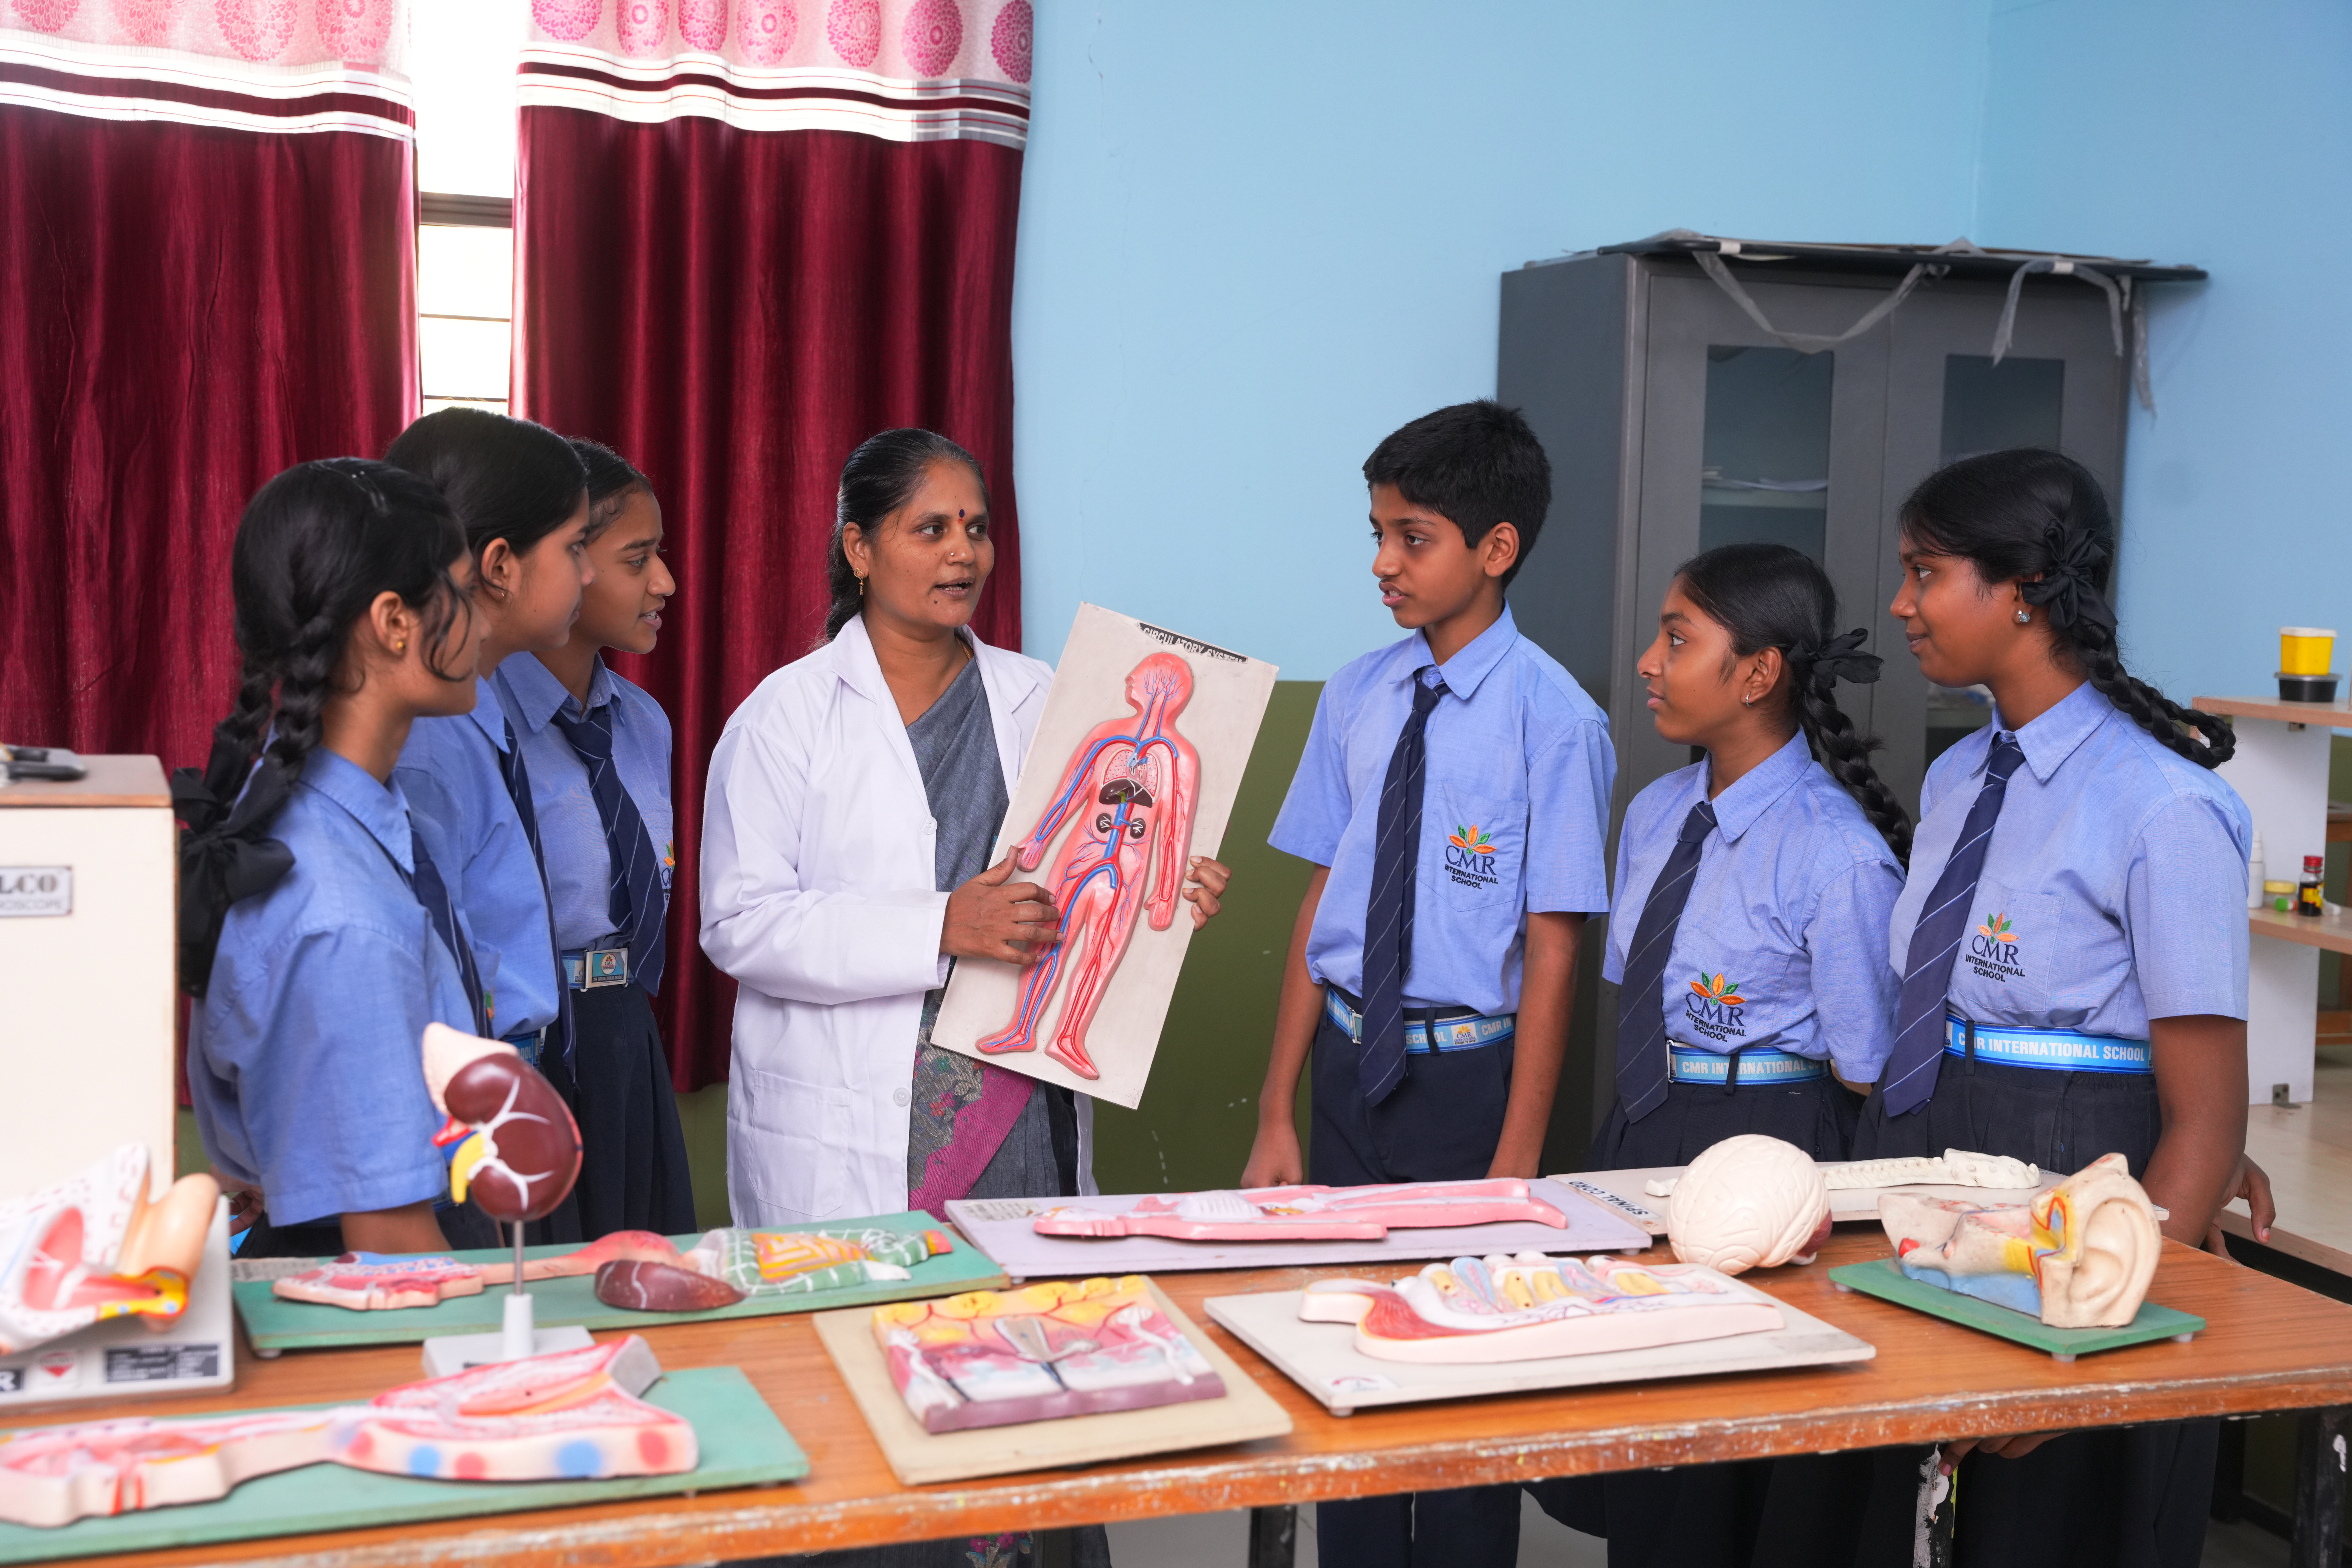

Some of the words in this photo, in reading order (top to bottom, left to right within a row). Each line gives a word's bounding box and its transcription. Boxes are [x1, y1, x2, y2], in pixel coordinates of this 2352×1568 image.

[1446, 845, 1497, 875] CMR
[1445, 864, 1498, 884] INTERNATIONAL
[1452, 875, 1482, 889] SCHOOL
[1972, 935, 2021, 965] CMR
[1965, 954, 2025, 977] INTERNATIONAL
[1973, 966, 2005, 982] SCHOOL
[1686, 992, 1746, 1027] CMR
[1481, 1020, 1502, 1035] CMR
[1686, 1009, 1746, 1036] INTERNATIONAL
[1406, 1032, 1447, 1044] SCHOL
[1694, 1024, 1727, 1042] SCHOOL
[1989, 1038, 2099, 1058] INTERNATIONAL
[2103, 1046, 2144, 1061] SCHOOL
[1682, 1061, 1708, 1073] CMR
[1712, 1059, 1806, 1074] INTRNATIONAL
[1568, 1181, 1605, 1194] CORD
[1602, 1194, 1648, 1214] SPINAL
